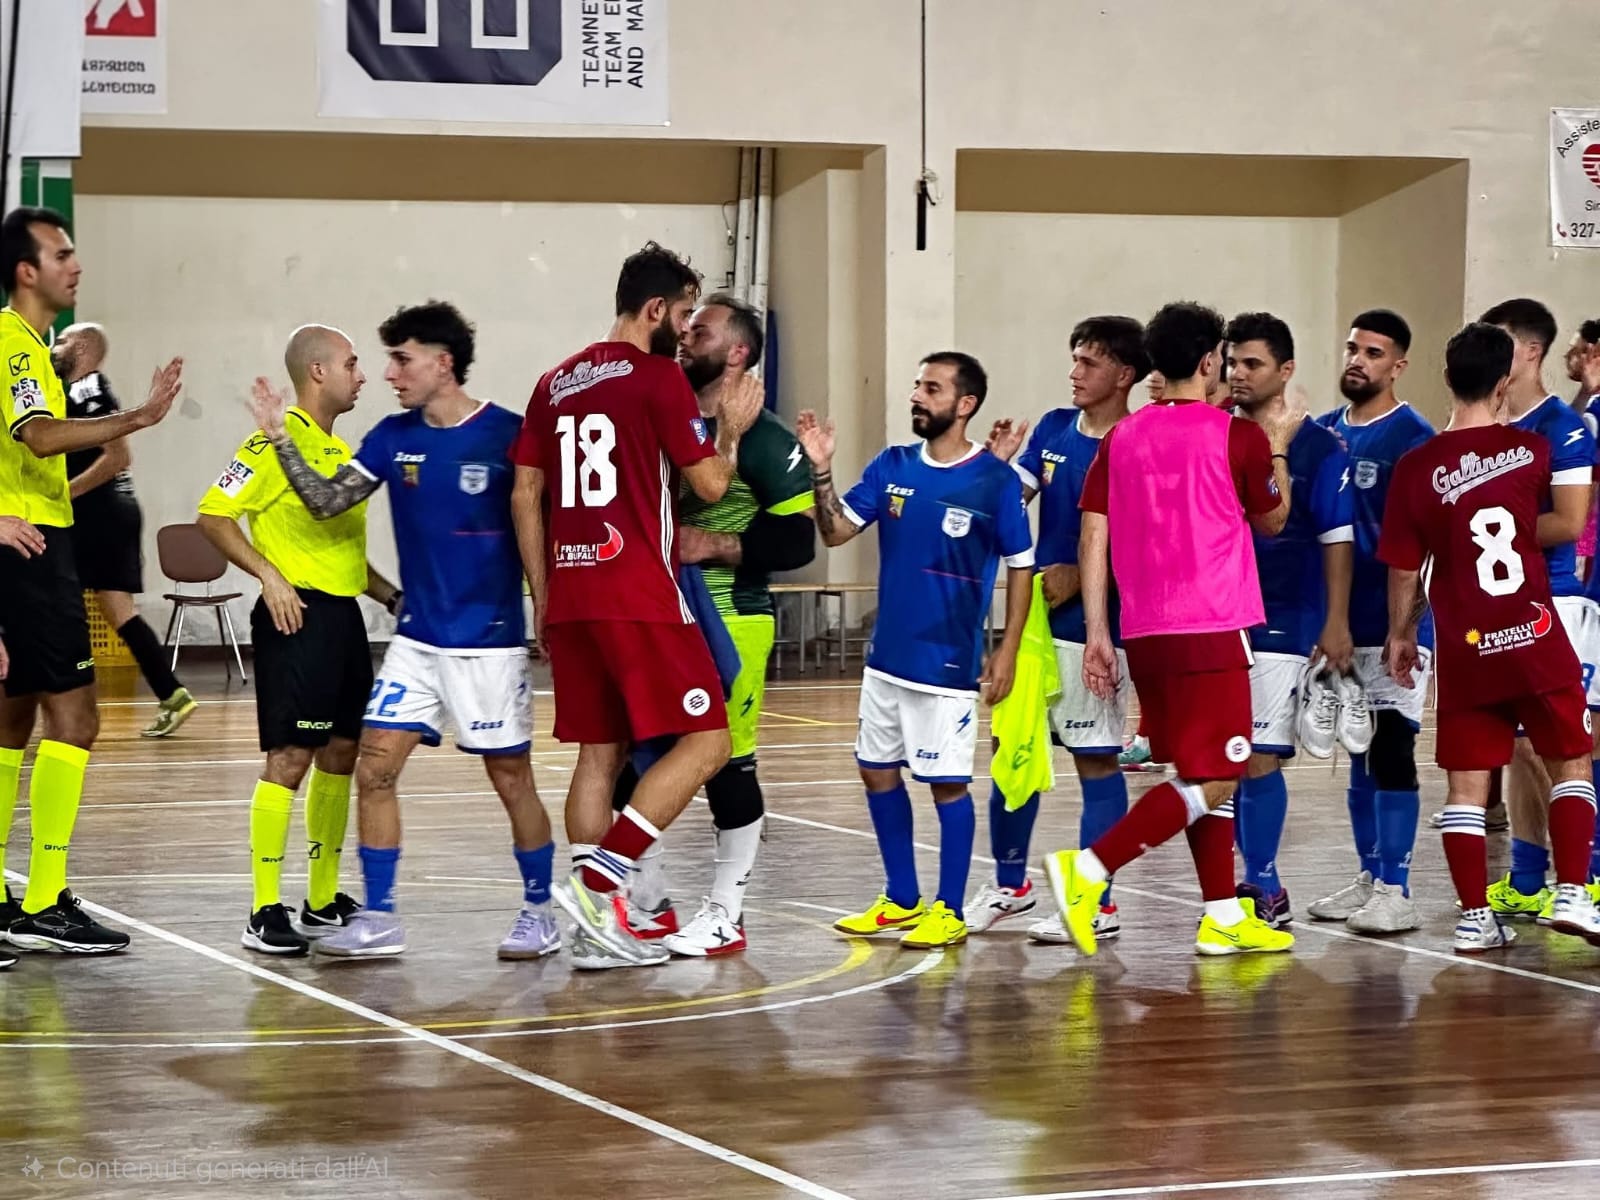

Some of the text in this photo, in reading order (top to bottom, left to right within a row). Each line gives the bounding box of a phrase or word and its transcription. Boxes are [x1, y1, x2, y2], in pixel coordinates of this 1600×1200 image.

[582, 0, 600, 88] TEAMNE
[603, 0, 622, 88] TEAM E
[626, 0, 644, 88] AND MA
[555, 413, 617, 508] 18
[1040, 449, 1068, 463] Zeus
[1432, 446, 1527, 494] Gallinese
[884, 483, 916, 497] Zeus
[1469, 505, 1526, 597] 8
[1478, 630, 1533, 650] LA BUFALA
[1484, 622, 1531, 640] FRATELLI
[470, 720, 504, 731] Zeus
[1065, 719, 1096, 730] Zeus
